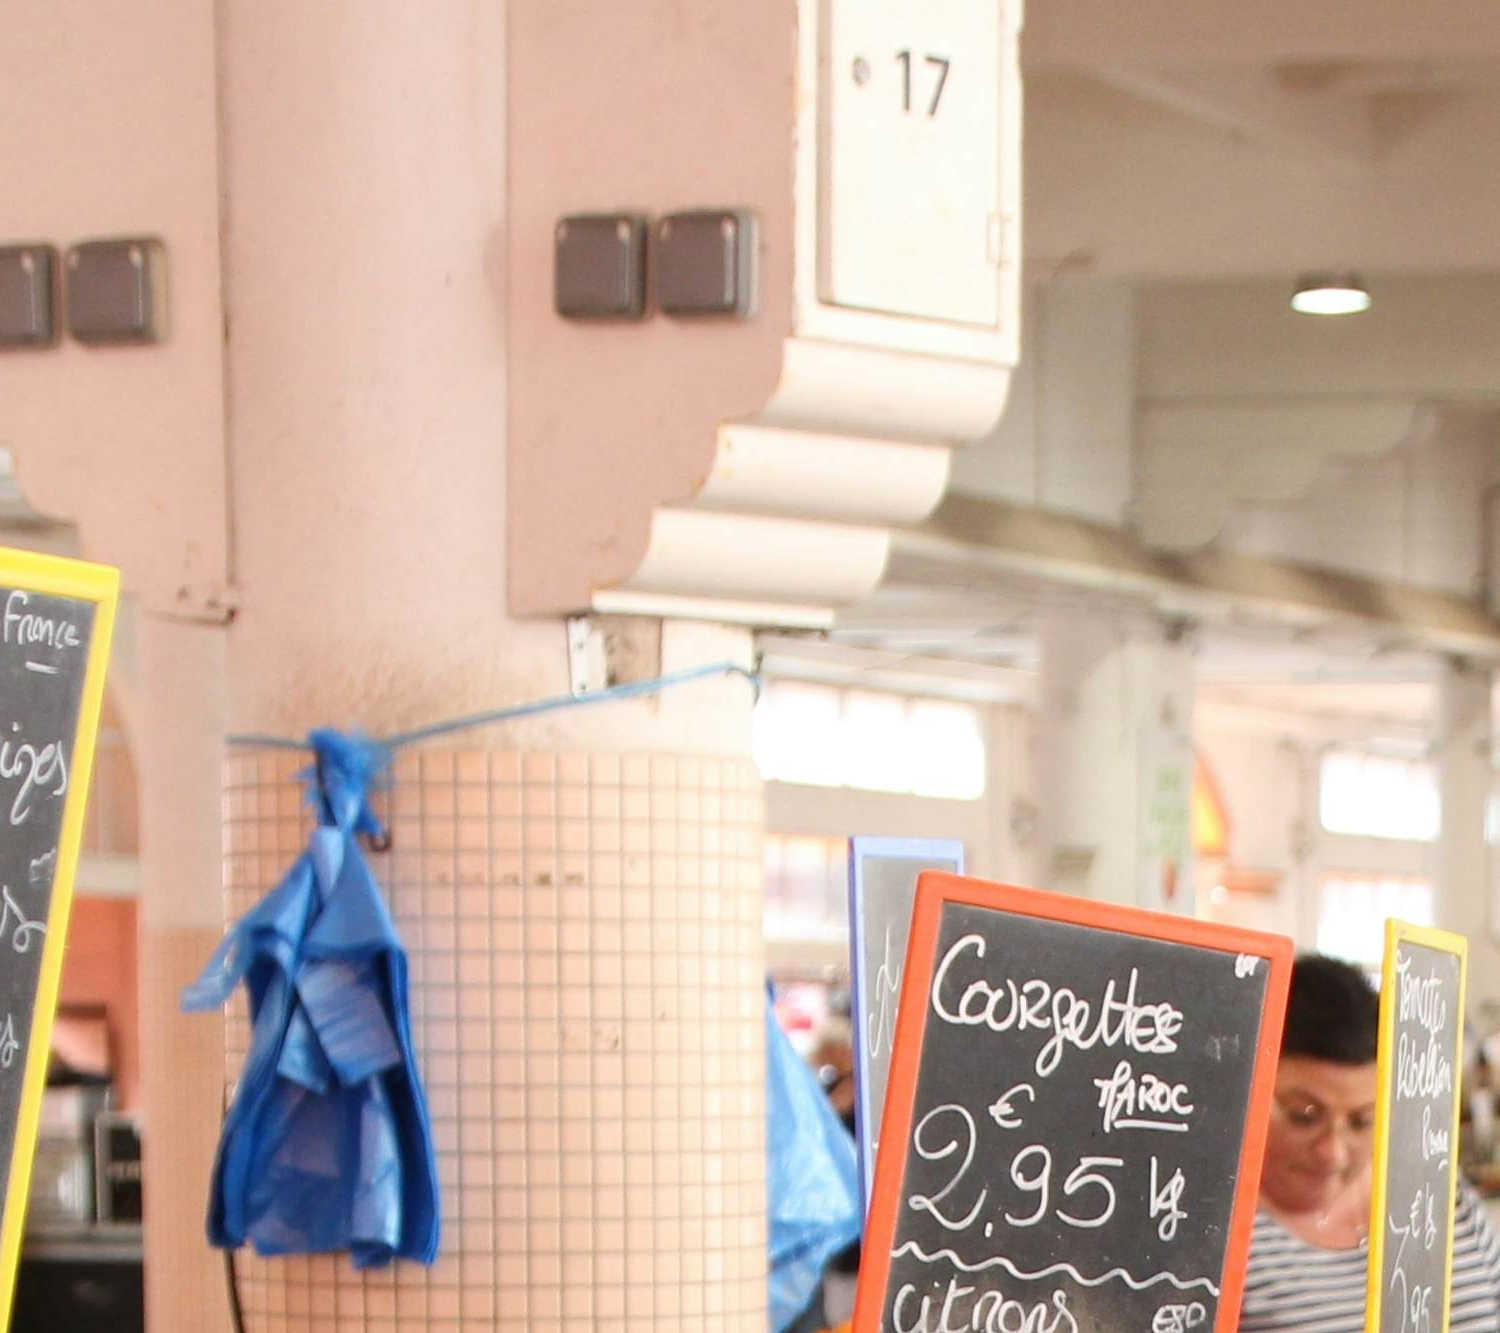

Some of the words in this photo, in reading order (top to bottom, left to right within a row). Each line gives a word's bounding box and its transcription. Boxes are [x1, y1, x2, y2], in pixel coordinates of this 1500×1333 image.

[896, 50, 950, 116] 17
[3, 590, 81, 648] France
[1094, 1060, 1195, 1133] MAROC
